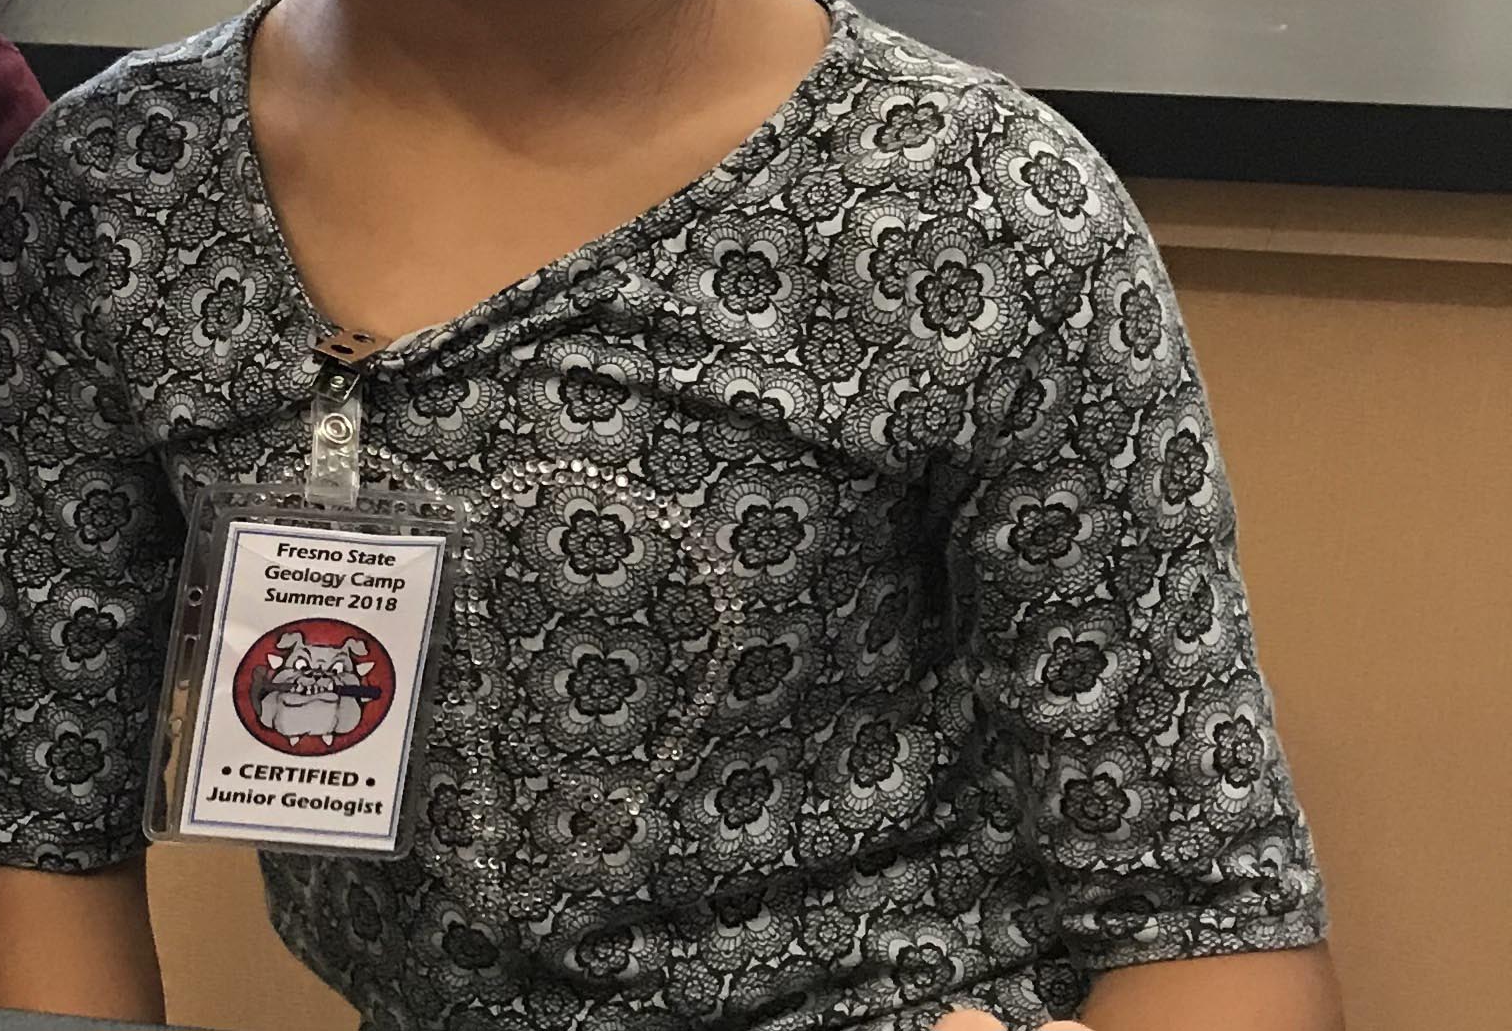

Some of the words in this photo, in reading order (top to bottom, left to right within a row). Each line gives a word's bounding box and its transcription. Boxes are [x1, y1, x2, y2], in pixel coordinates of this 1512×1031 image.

[276, 542, 344, 563] Fresno
[346, 549, 397, 567] State
[264, 564, 347, 589] Geology
[350, 571, 406, 592] Camp
[264, 588, 345, 608] Summer
[347, 593, 398, 612] 2018
[238, 763, 360, 787] CERTIFIED
[205, 786, 277, 807] Junior
[280, 792, 384, 817] Geologist
